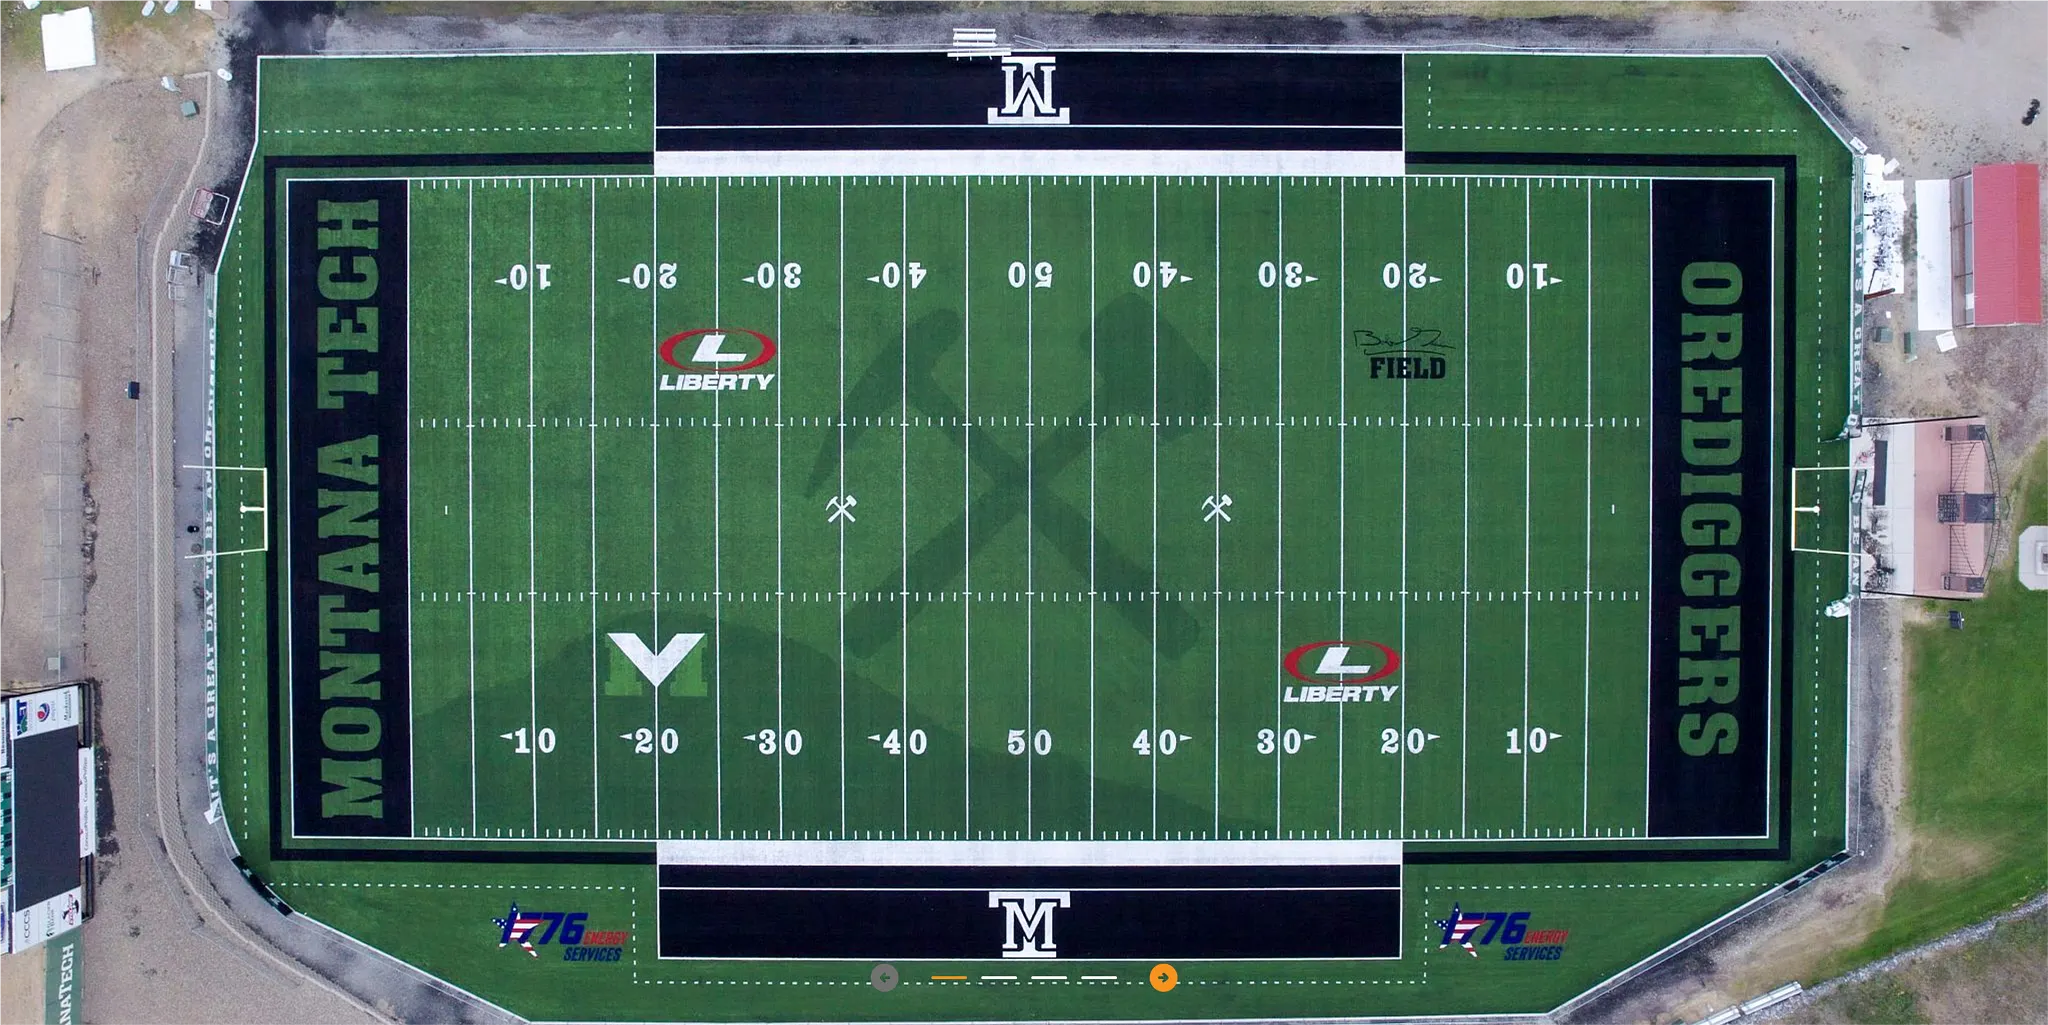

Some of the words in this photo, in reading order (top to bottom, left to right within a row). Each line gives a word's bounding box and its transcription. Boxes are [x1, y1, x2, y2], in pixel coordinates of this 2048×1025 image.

[510, 264, 551, 290] 10
[634, 263, 677, 289] 20
[758, 262, 802, 289] 30
[883, 262, 927, 289] 40
[1009, 261, 1053, 288] 50
[1134, 261, 1178, 288] 40
[1259, 261, 1303, 288] 30
[1383, 262, 1427, 289] 20
[1507, 263, 1548, 290] 10
[317, 199, 379, 409] TECH
[1854, 303, 1863, 317] A
[1370, 357, 1446, 379] FIELD
[1852, 326, 1862, 405] GREAT
[660, 374, 775, 391] LIBERTY
[204, 469, 212, 499] AN
[1678, 261, 1743, 756] OREDIGGERS
[205, 509, 213, 539] BE
[1852, 514, 1861, 546] BE
[205, 550, 214, 579] TO
[1852, 556, 1861, 587] AN
[205, 589, 215, 632] DAY
[317, 435, 382, 819] MONTANA
[206, 643, 216, 719] GREAT
[1284, 686, 1399, 702] LIBERTY
[206, 728, 216, 741] A
[515, 727, 556, 754] 10
[636, 728, 679, 754] 20
[759, 729, 803, 755] 30
[883, 729, 927, 755] 40
[1008, 729, 1052, 755] 50
[1133, 729, 1177, 755] 40
[1258, 728, 1301, 755] 30
[1382, 728, 1425, 754] 20
[1507, 727, 1547, 754] 10
[206, 752, 219, 799] IT'S
[501, 911, 589, 945] 1776
[1441, 911, 1532, 945] 1776
[563, 946, 623, 962] SERVICES
[1503, 946, 1564, 961] SERVICES
